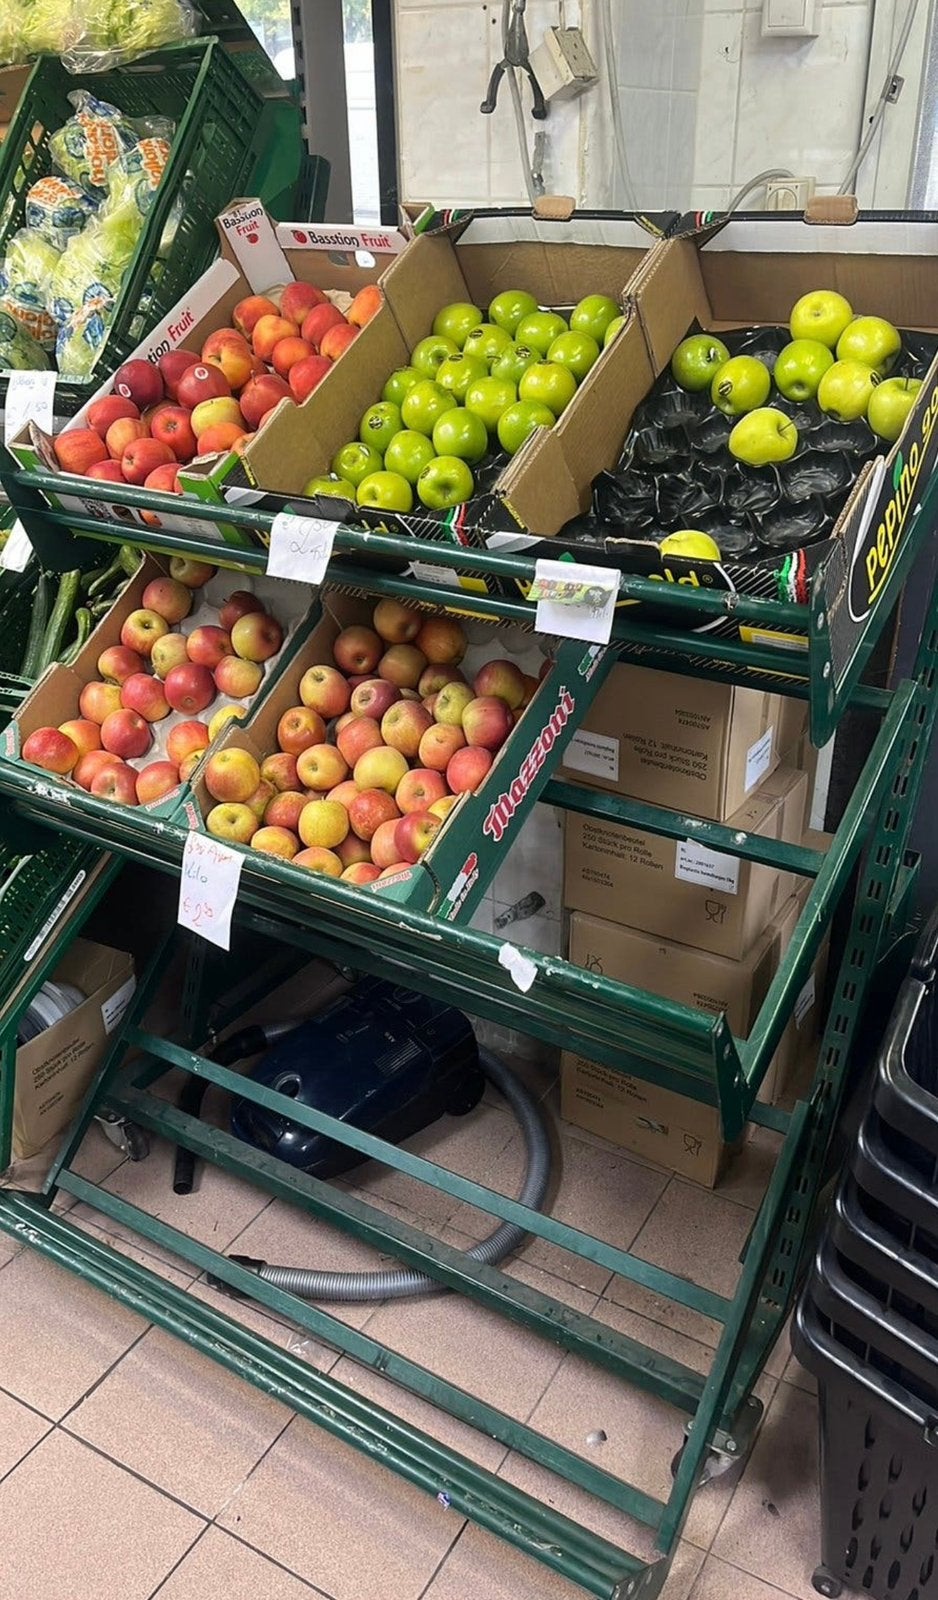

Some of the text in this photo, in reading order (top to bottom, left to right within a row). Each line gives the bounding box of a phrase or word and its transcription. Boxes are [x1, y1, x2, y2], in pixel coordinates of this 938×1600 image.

[223, 207, 263, 229] Basstion
[236, 220, 260, 236] Fruit
[309, 231, 391, 248] Basstion Fruit
[167, 311, 195, 342] Fruit
[866, 442, 918, 591] pepino
[483, 685, 575, 842] Mazzoni
[629, 854, 638, 863] 12
